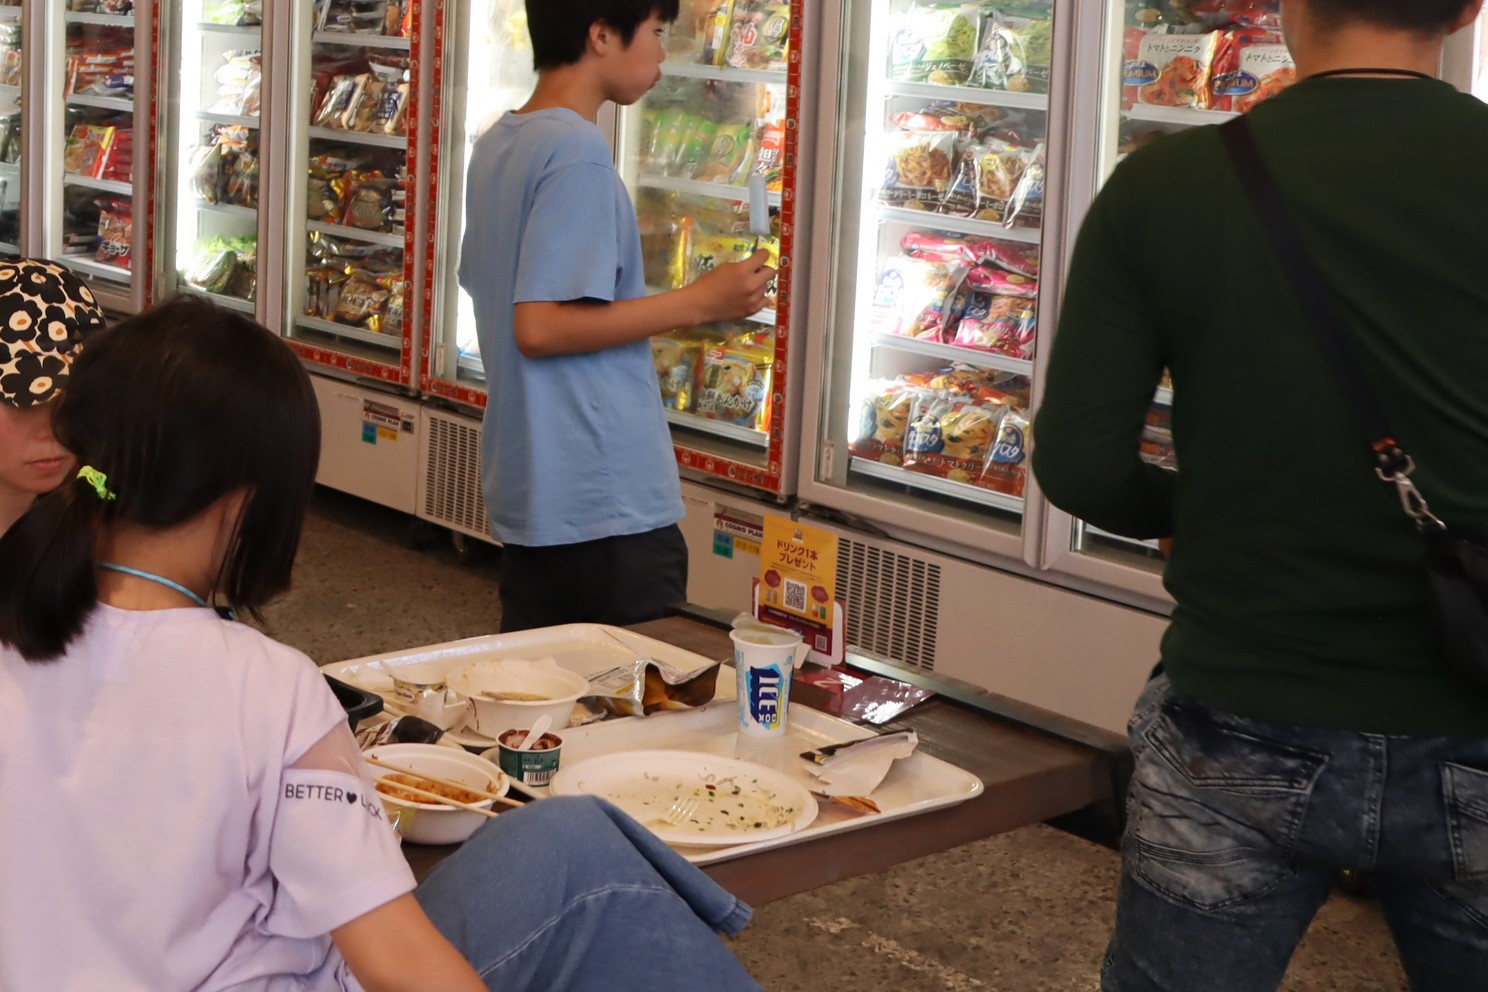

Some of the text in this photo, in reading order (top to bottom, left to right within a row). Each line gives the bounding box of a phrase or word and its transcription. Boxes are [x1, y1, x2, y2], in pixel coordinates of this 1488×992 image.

[725, 522, 747, 533] COSMO
[776, 539, 819, 561] ドリンク1本
[778, 552, 817, 571] プレゼント
[758, 675, 781, 711] ICE
[285, 783, 344, 803] BETTER
